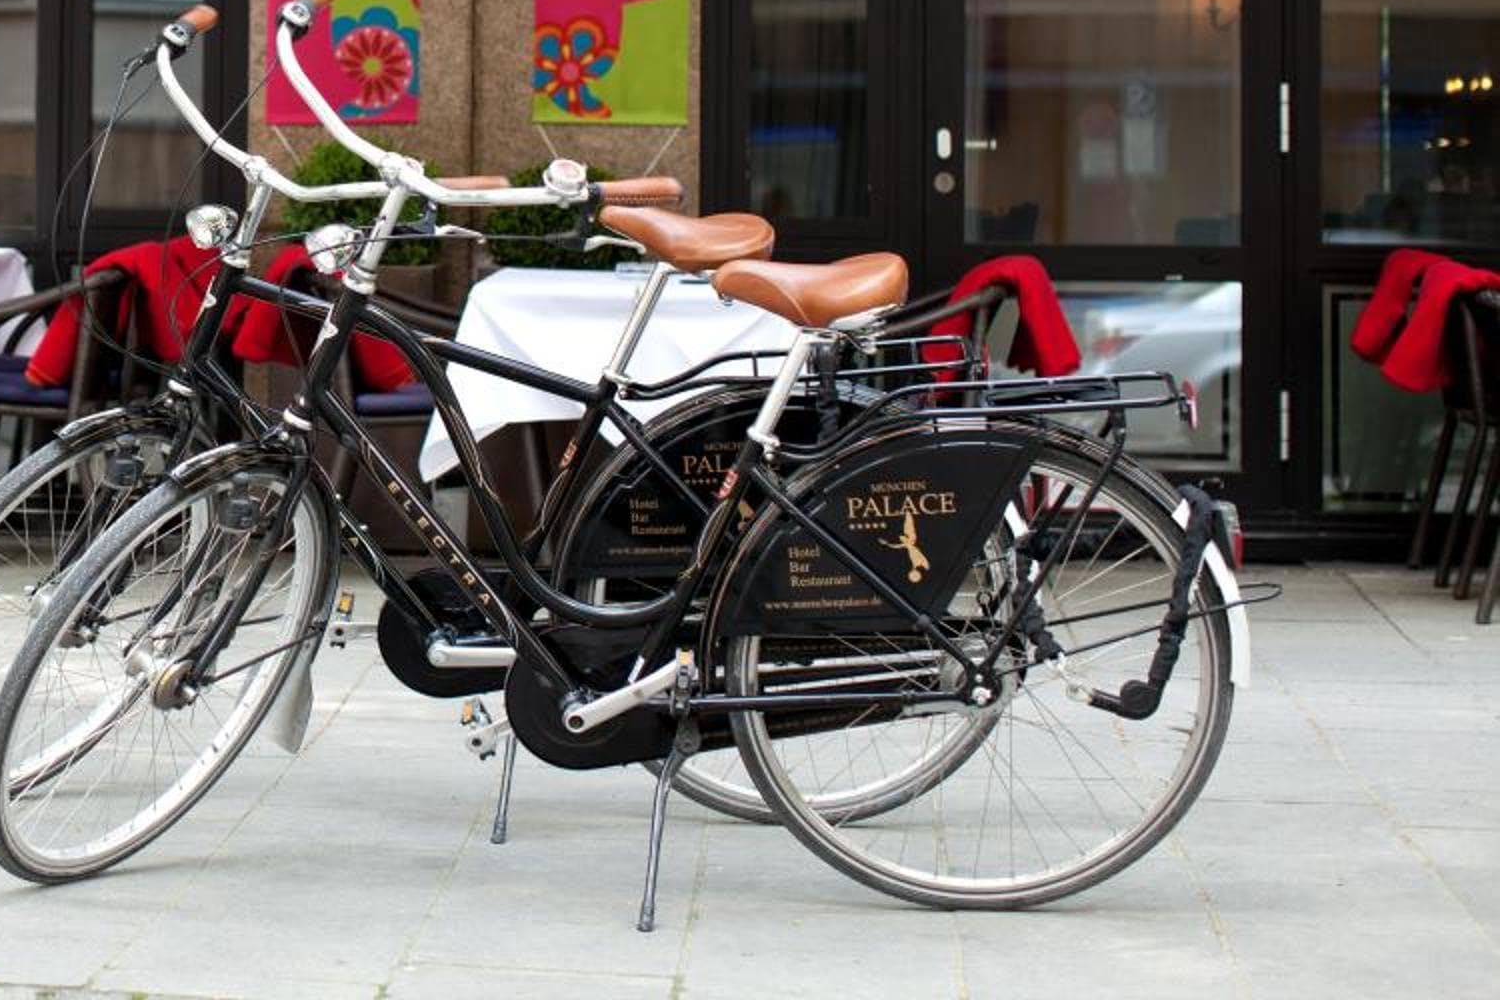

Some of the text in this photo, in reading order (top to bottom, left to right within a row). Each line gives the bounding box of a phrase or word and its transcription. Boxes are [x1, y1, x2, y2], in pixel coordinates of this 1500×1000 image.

[847, 492, 957, 518] PALACE
[387, 480, 491, 606] ELECTRA
[788, 544, 820, 559] Hotel
[789, 561, 809, 573] Bar
[790, 574, 852, 587] Restaurant
